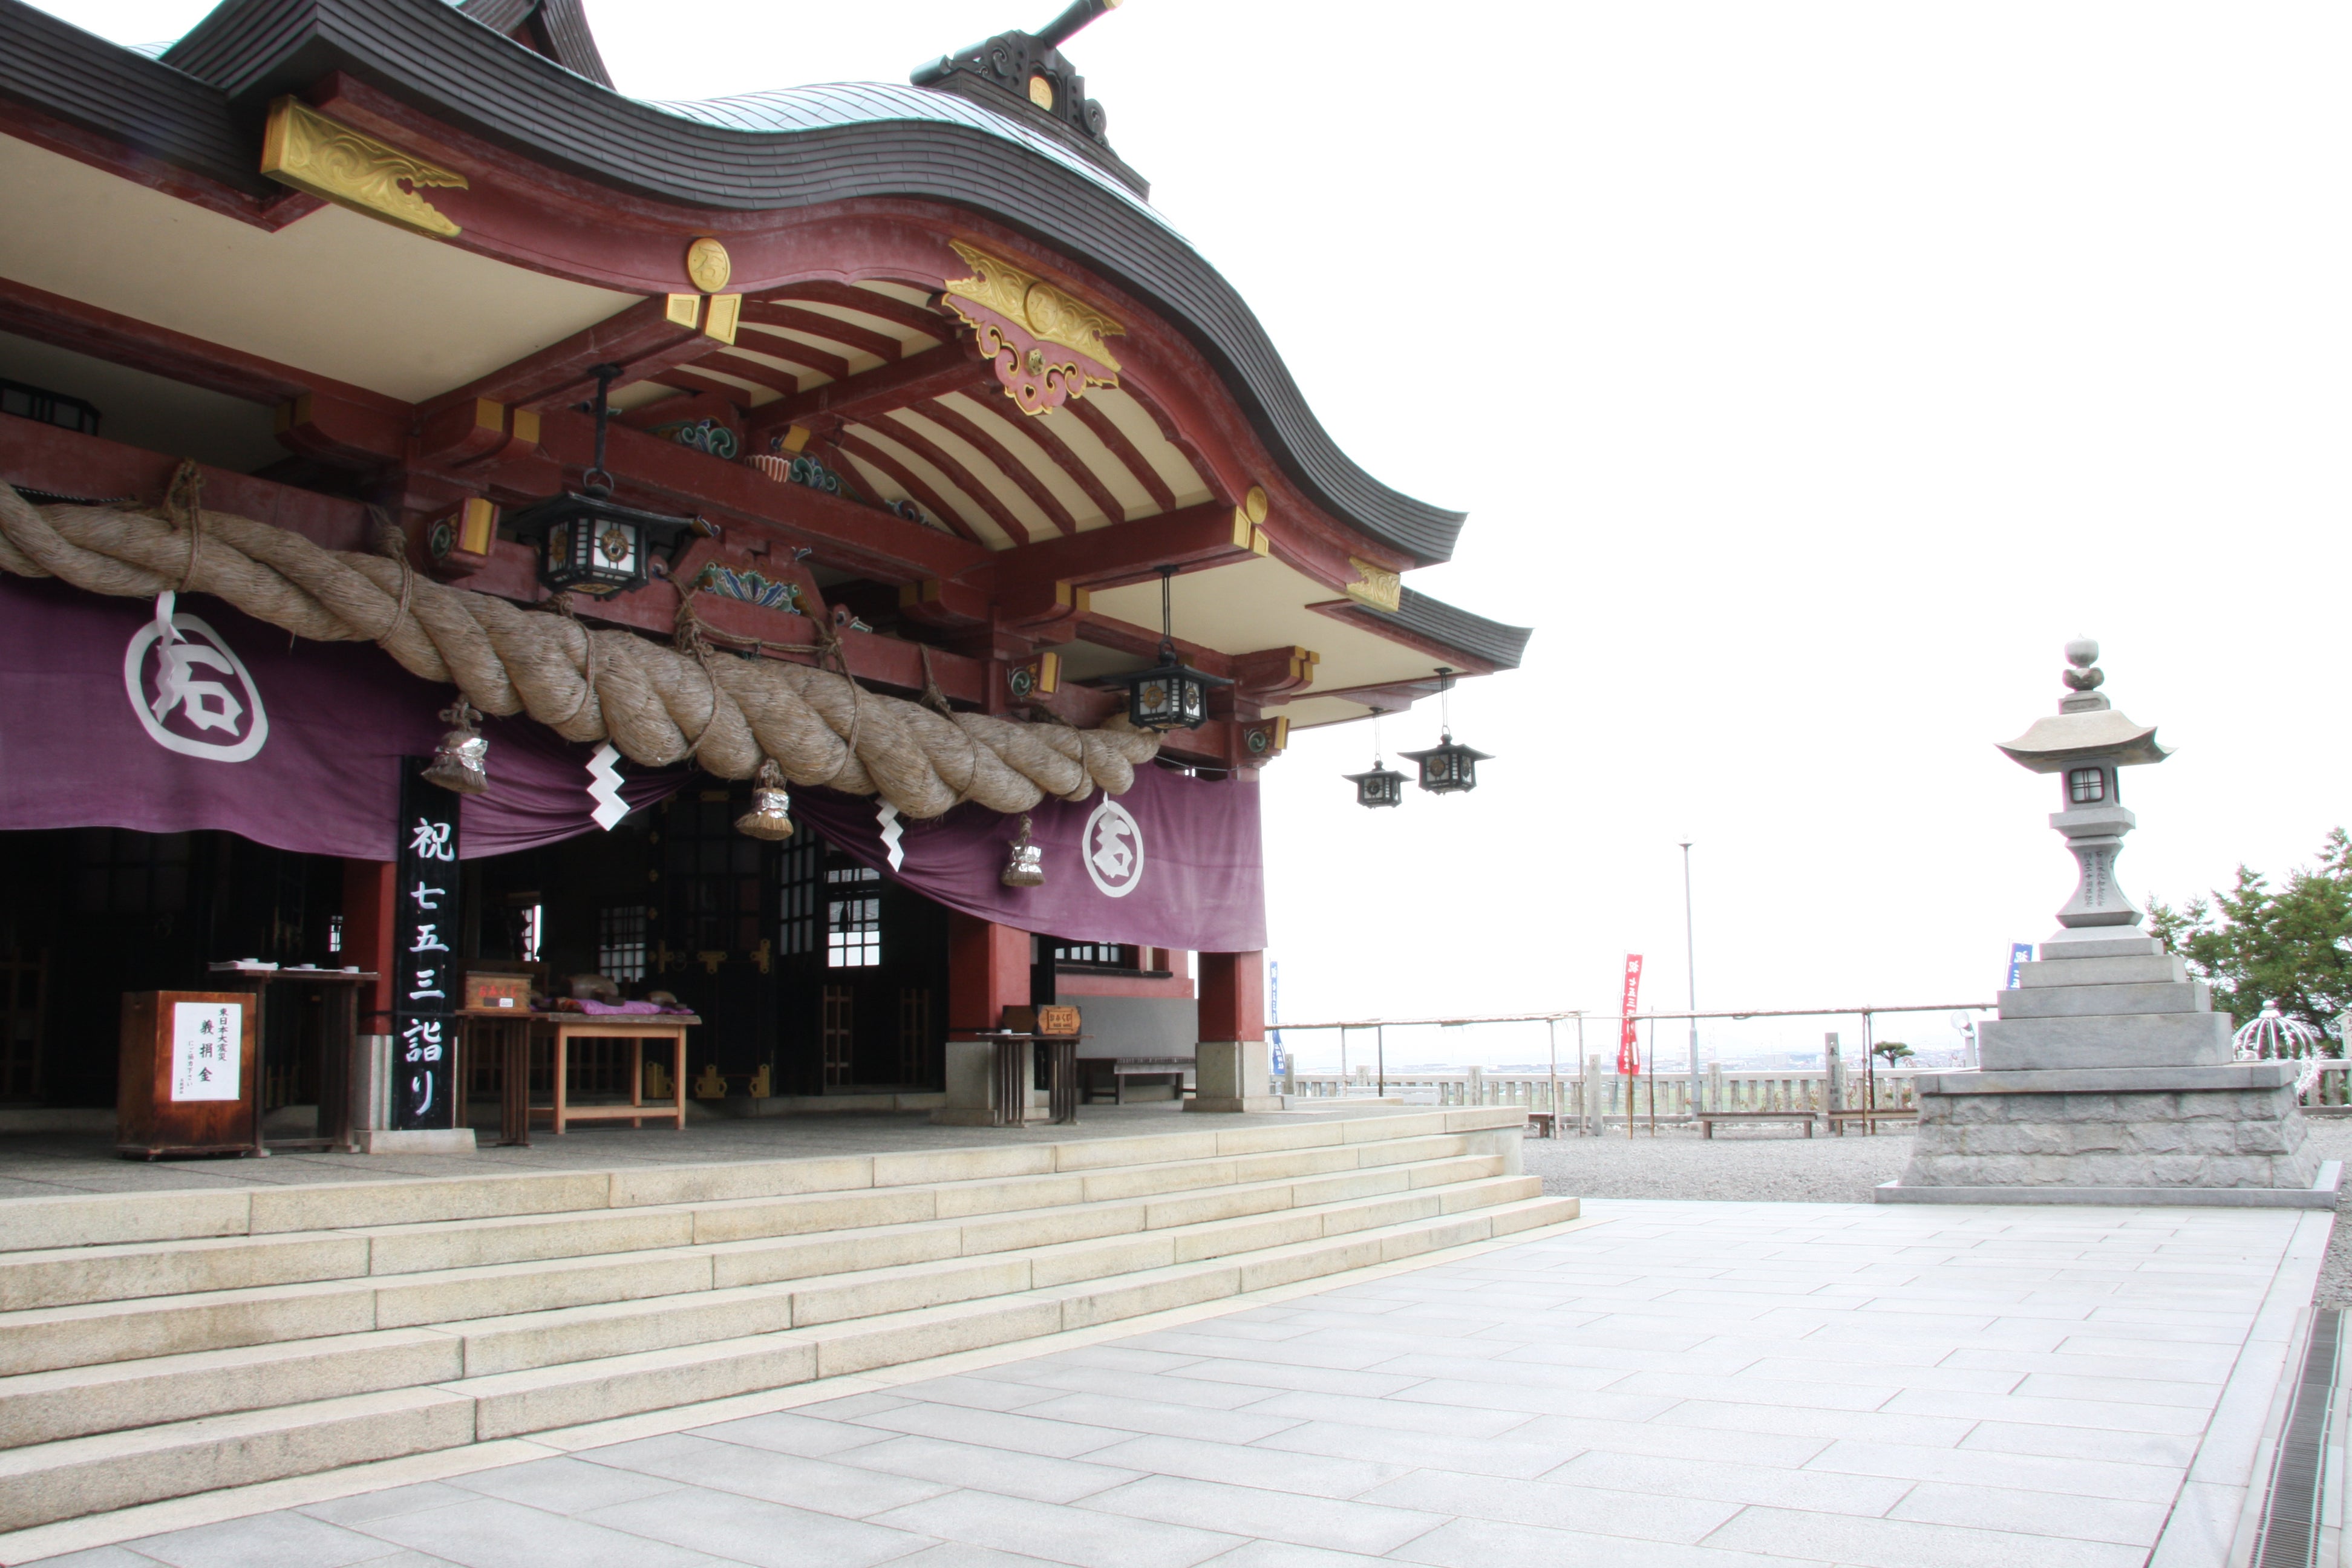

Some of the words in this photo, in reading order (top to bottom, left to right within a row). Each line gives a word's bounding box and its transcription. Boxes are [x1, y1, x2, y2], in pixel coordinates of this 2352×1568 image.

[403, 817, 455, 1115] 祝七五三詣り
[198, 1019, 214, 1082] 義捐金
[218, 1008, 229, 1061] 東日本大震災
